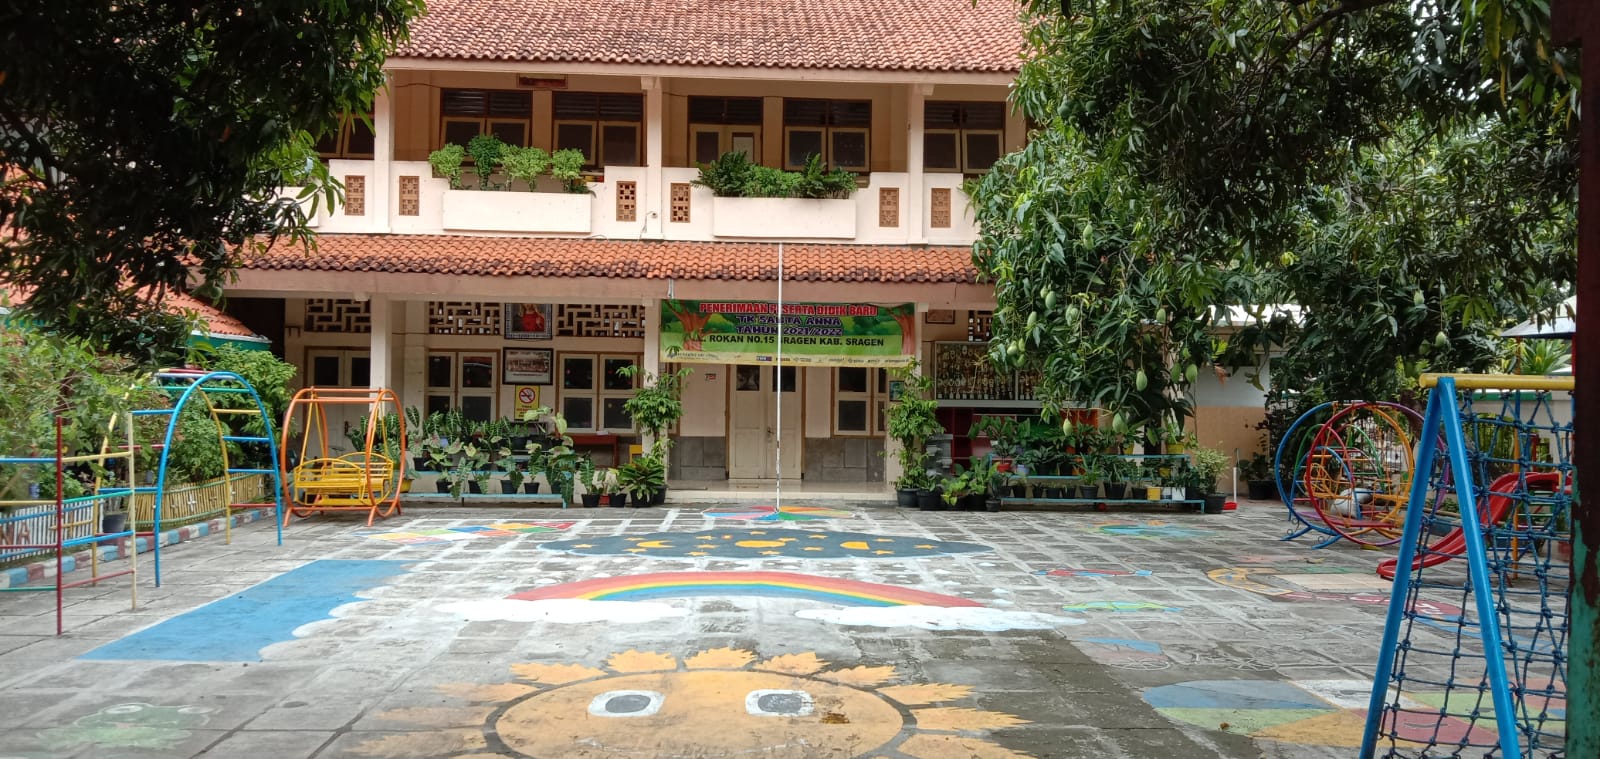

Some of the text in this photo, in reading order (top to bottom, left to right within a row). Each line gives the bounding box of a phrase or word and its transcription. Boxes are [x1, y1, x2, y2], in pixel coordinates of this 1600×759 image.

[700, 303, 877, 316] PENERIMAAN PSERTA DIDIK BARU
[736, 315, 755, 324] TK
[806, 316, 842, 326] ANNA
[736, 325, 843, 336] TAHUN 2021/2022
[709, 334, 744, 343] ROKAN
[747, 335, 775, 344] NO.15
[778, 336, 817, 345] RAGEN
[819, 337, 843, 346] KAB.
[846, 338, 884, 347] SRAGEN
